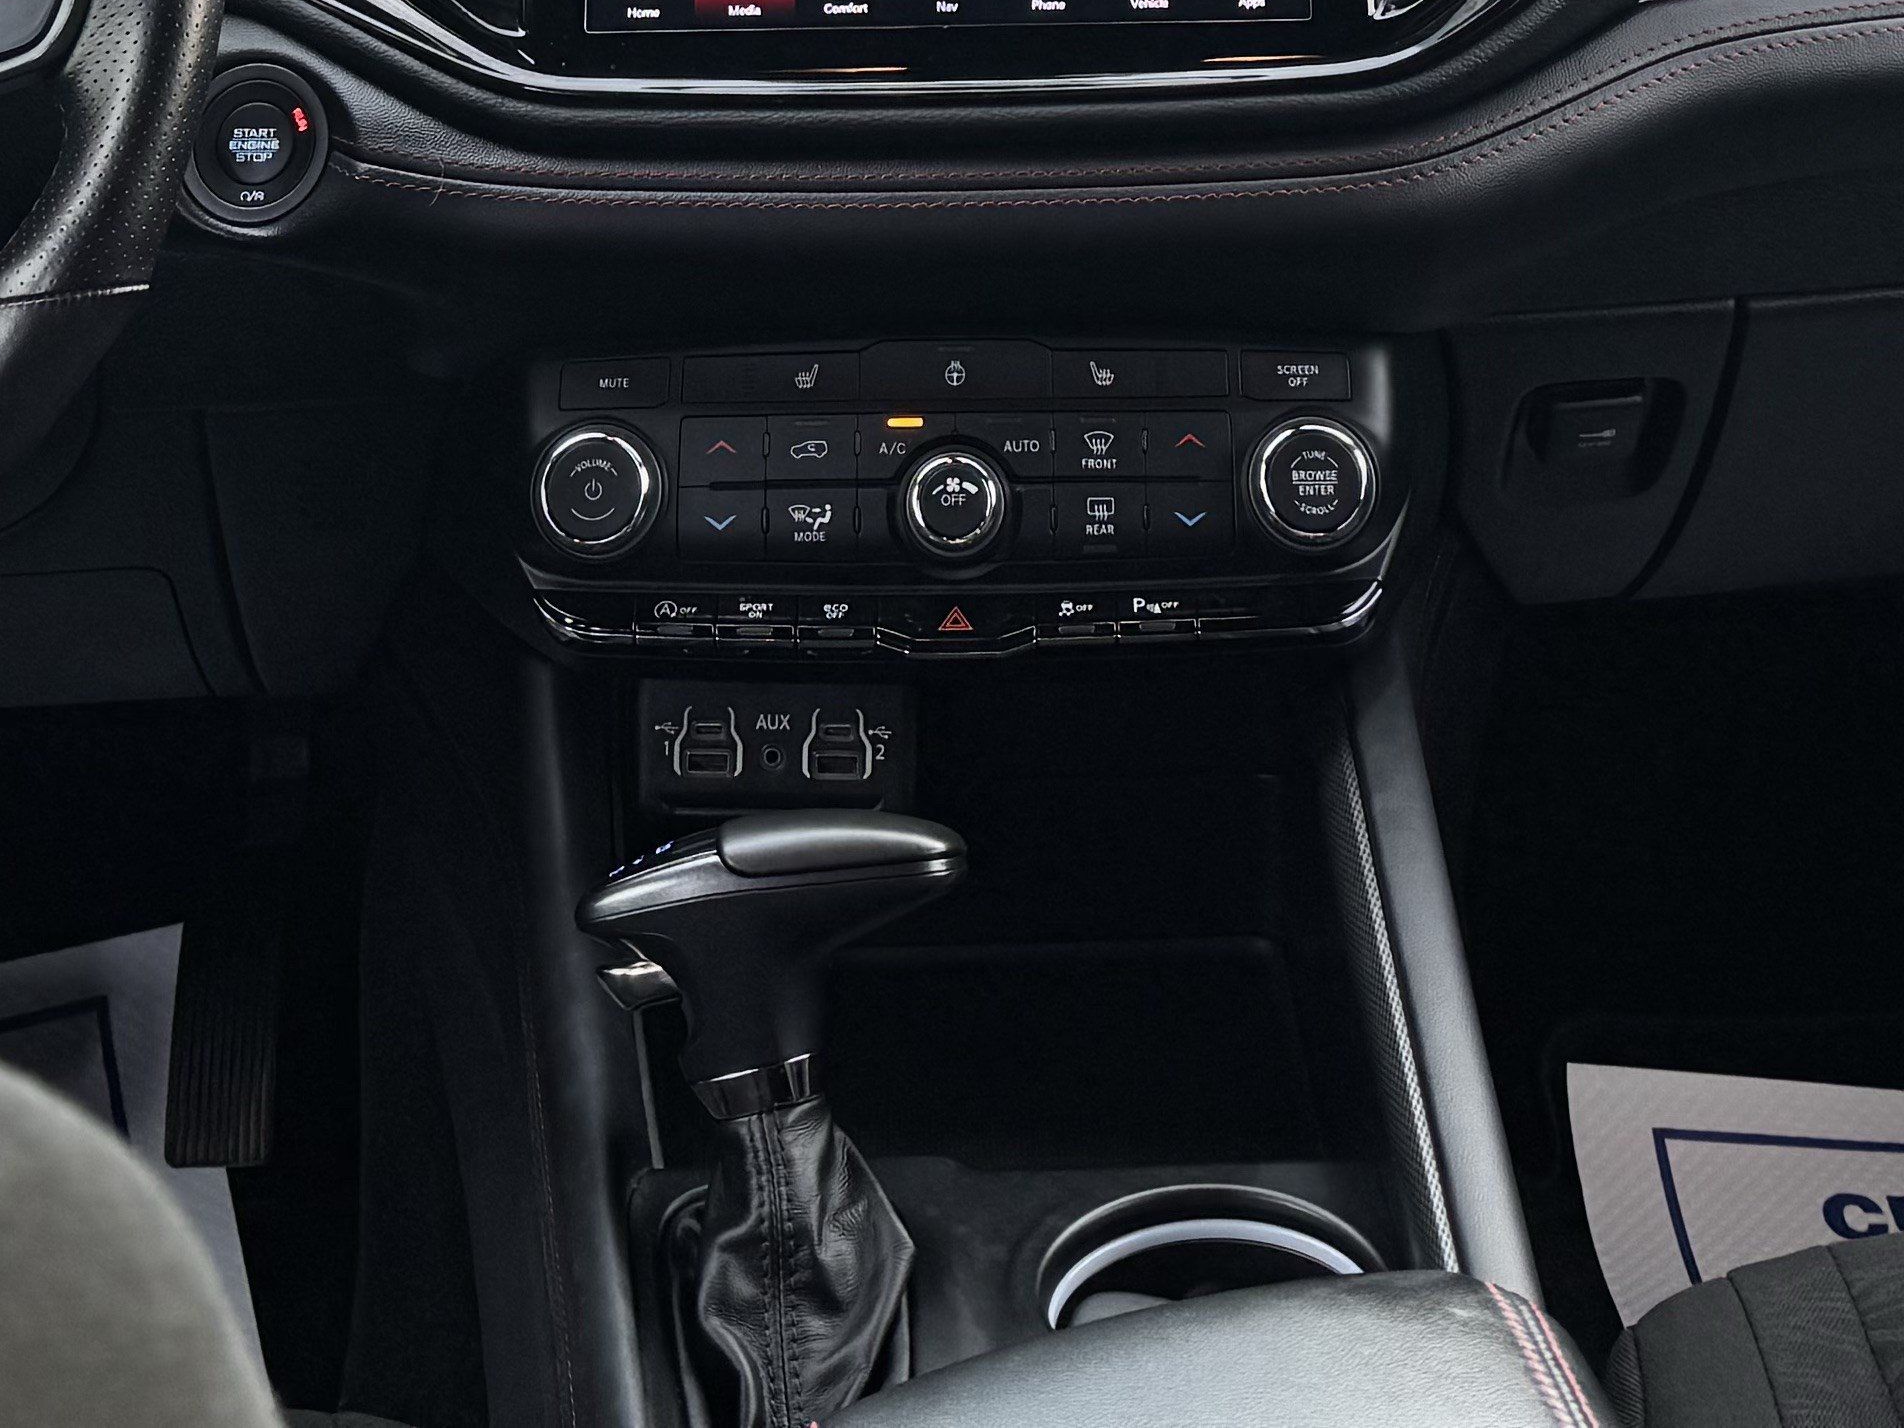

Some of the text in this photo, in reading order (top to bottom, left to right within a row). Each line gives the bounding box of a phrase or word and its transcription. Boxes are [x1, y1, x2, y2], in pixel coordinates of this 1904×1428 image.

[626, 6, 661, 19] Home
[727, 4, 762, 17] Media
[822, 1, 869, 15] Comfort
[936, 0, 959, 13] Nav
[233, 128, 277, 138] START
[229, 139, 280, 150] ENGINE
[235, 152, 273, 162] STOP
[1276, 363, 1319, 376] SCREEN
[599, 377, 630, 390] MUTE
[1288, 376, 1308, 388] OFF
[878, 441, 907, 455] A/C
[1003, 439, 1040, 453] AUTO
[1301, 449, 1327, 462] TUNE
[574, 458, 614, 473] VOLUME
[1081, 457, 1117, 470] FRONT
[1292, 469, 1338, 482] BROWSE
[1298, 484, 1335, 497] ENTER
[940, 493, 966, 507] OFF
[1298, 501, 1335, 516] SCROLL
[1085, 523, 1115, 536] REAR
[793, 530, 826, 543] MODE
[739, 602, 774, 612] SPORT
[748, 610, 763, 619] ON
[825, 610, 845, 619] OFF
[755, 714, 791, 731] AUX
[875, 744, 885, 760] 2
